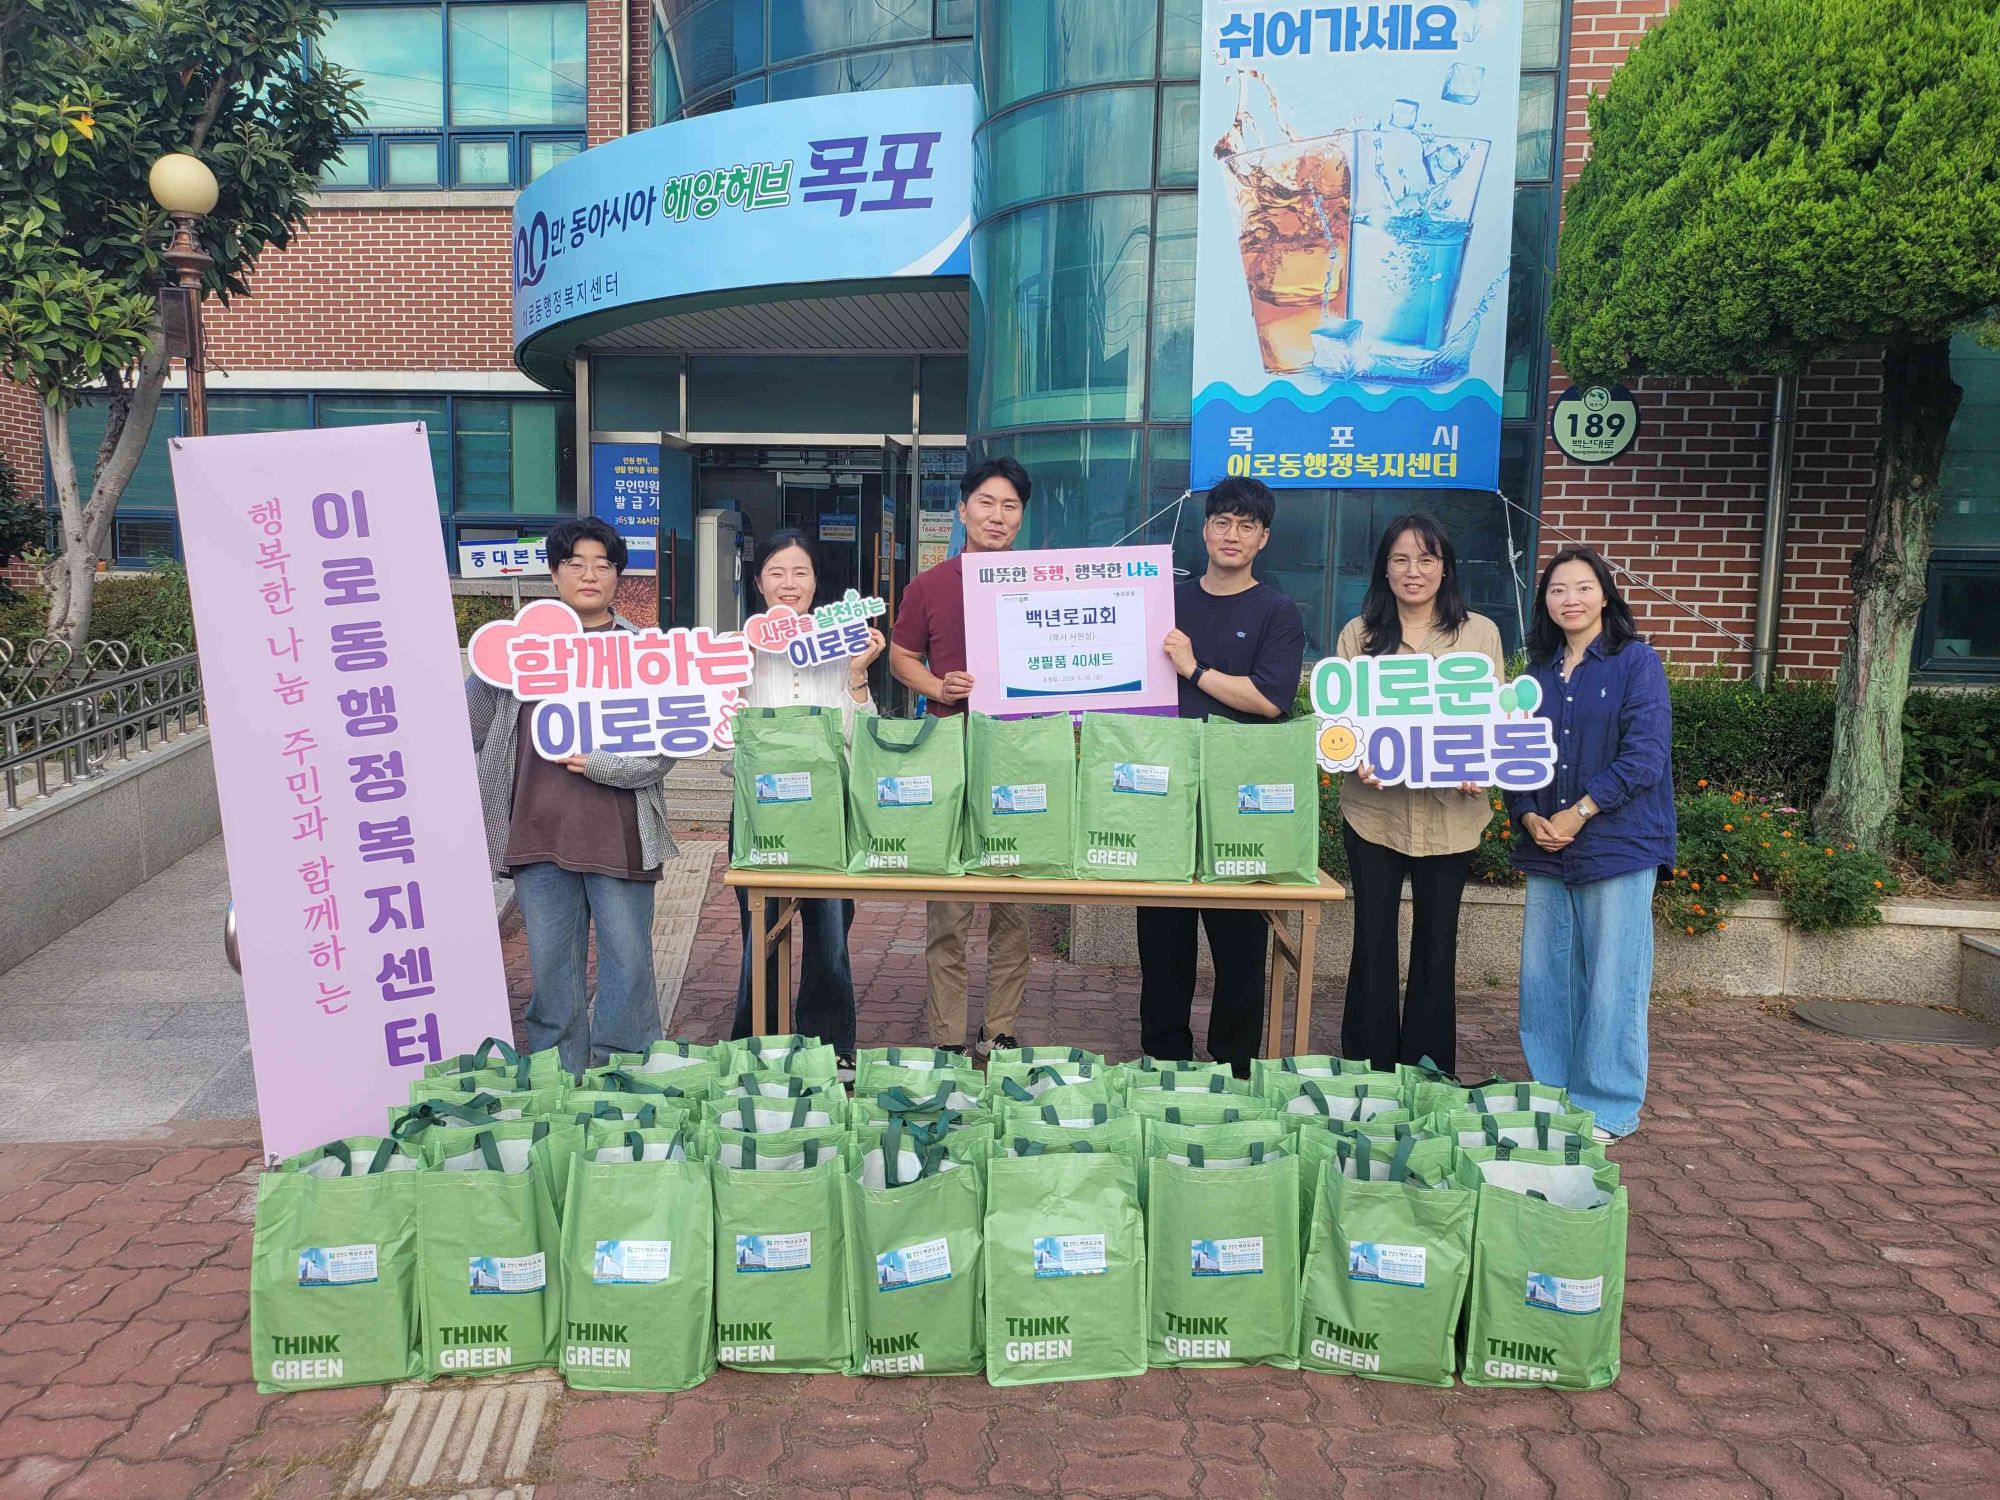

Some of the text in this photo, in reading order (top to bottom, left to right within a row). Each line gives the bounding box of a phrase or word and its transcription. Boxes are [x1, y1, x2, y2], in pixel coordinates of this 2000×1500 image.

[1219, 4, 1459, 59] 쉬어가세요
[570, 187, 657, 249] 동아시아
[662, 159, 792, 221] 해양허브
[799, 131, 942, 217] 목포
[522, 270, 618, 329] 이로동행정복지센터
[1567, 413, 1625, 438] 189
[1572, 439, 1614, 449] 백년대로
[1227, 452, 1457, 478] 이로동행정복지센터
[614, 480, 660, 494] 무인민원
[614, 516, 660, 525] 365일 24시간
[979, 561, 1159, 584] 따뜻한 동행, 행복한 나눔
[760, 599, 884, 644] 사랑을 실천하는
[1026, 606, 1116, 628] 백년로교회
[789, 622, 870, 666] 이로동
[511, 632, 749, 696] 함께하는
[1028, 653, 1114, 670] 생필품 40세트
[1316, 657, 1493, 717] 이로운
[537, 695, 711, 755] 이로동
[248, 497, 351, 1014] 행복한 나눔 주민과 함께하는
[1368, 723, 1551, 785] 이로동
[312, 490, 443, 1067] 이로동행정복지센터
[1088, 831, 1137, 848] THINK
[1214, 842, 1265, 857] THINK
[1087, 850, 1137, 866] GREEN
[1214, 860, 1266, 876] GREEN
[439, 1324, 508, 1345] THINK
[566, 1320, 628, 1342] THINK
[717, 1322, 773, 1341] HINK
[1005, 1315, 1070, 1336] THINK
[1165, 1311, 1229, 1335] THINK
[1315, 1316, 1380, 1350] THINK
[272, 1334, 340, 1354] THINK
[717, 1345, 775, 1362] REEN
[1005, 1339, 1072, 1361] GREEN
[1164, 1335, 1231, 1358] GREEN
[1310, 1339, 1380, 1372] GREEN
[1487, 1337, 1558, 1365] THINK
[440, 1347, 512, 1368] GREEN
[566, 1346, 630, 1367] GREEN
[271, 1358, 343, 1380] GREEN
[1484, 1360, 1558, 1383] GREEN
